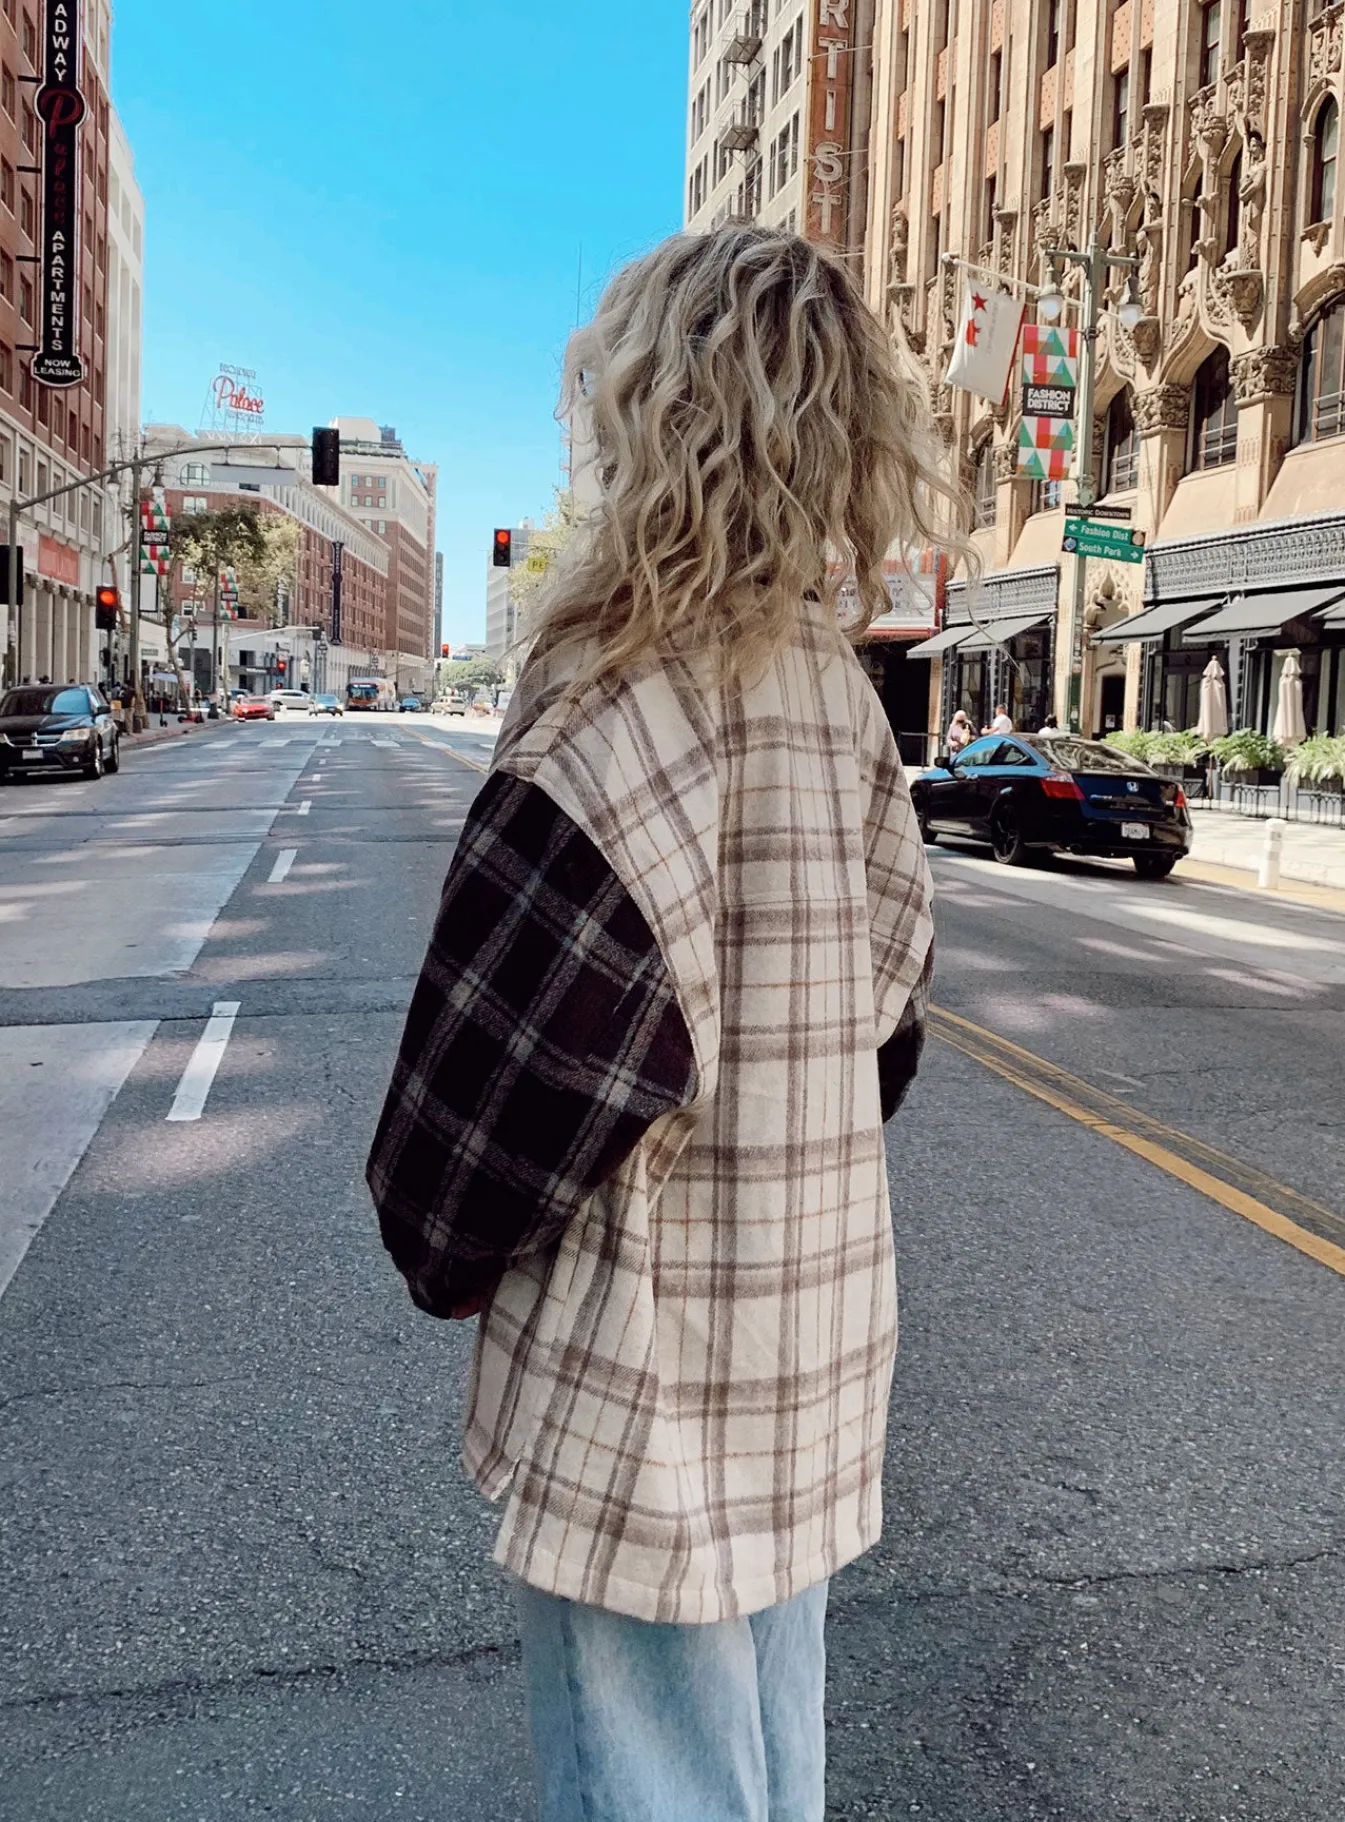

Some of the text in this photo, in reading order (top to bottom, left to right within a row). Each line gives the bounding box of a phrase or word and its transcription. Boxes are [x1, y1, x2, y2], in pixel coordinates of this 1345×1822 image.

[52, 3, 69, 82] ADWAY
[51, 230, 65, 351] APARTMENTS
[44, 359, 71, 367] NOW
[34, 367, 81, 377] LEASING
[213, 375, 264, 414] Palace
[1027, 388, 1071, 401] FASHION
[1027, 399, 1070, 411] DISTRICT
[1081, 526, 1128, 541] Fashion Dist
[1079, 542, 1122, 557] South Park
